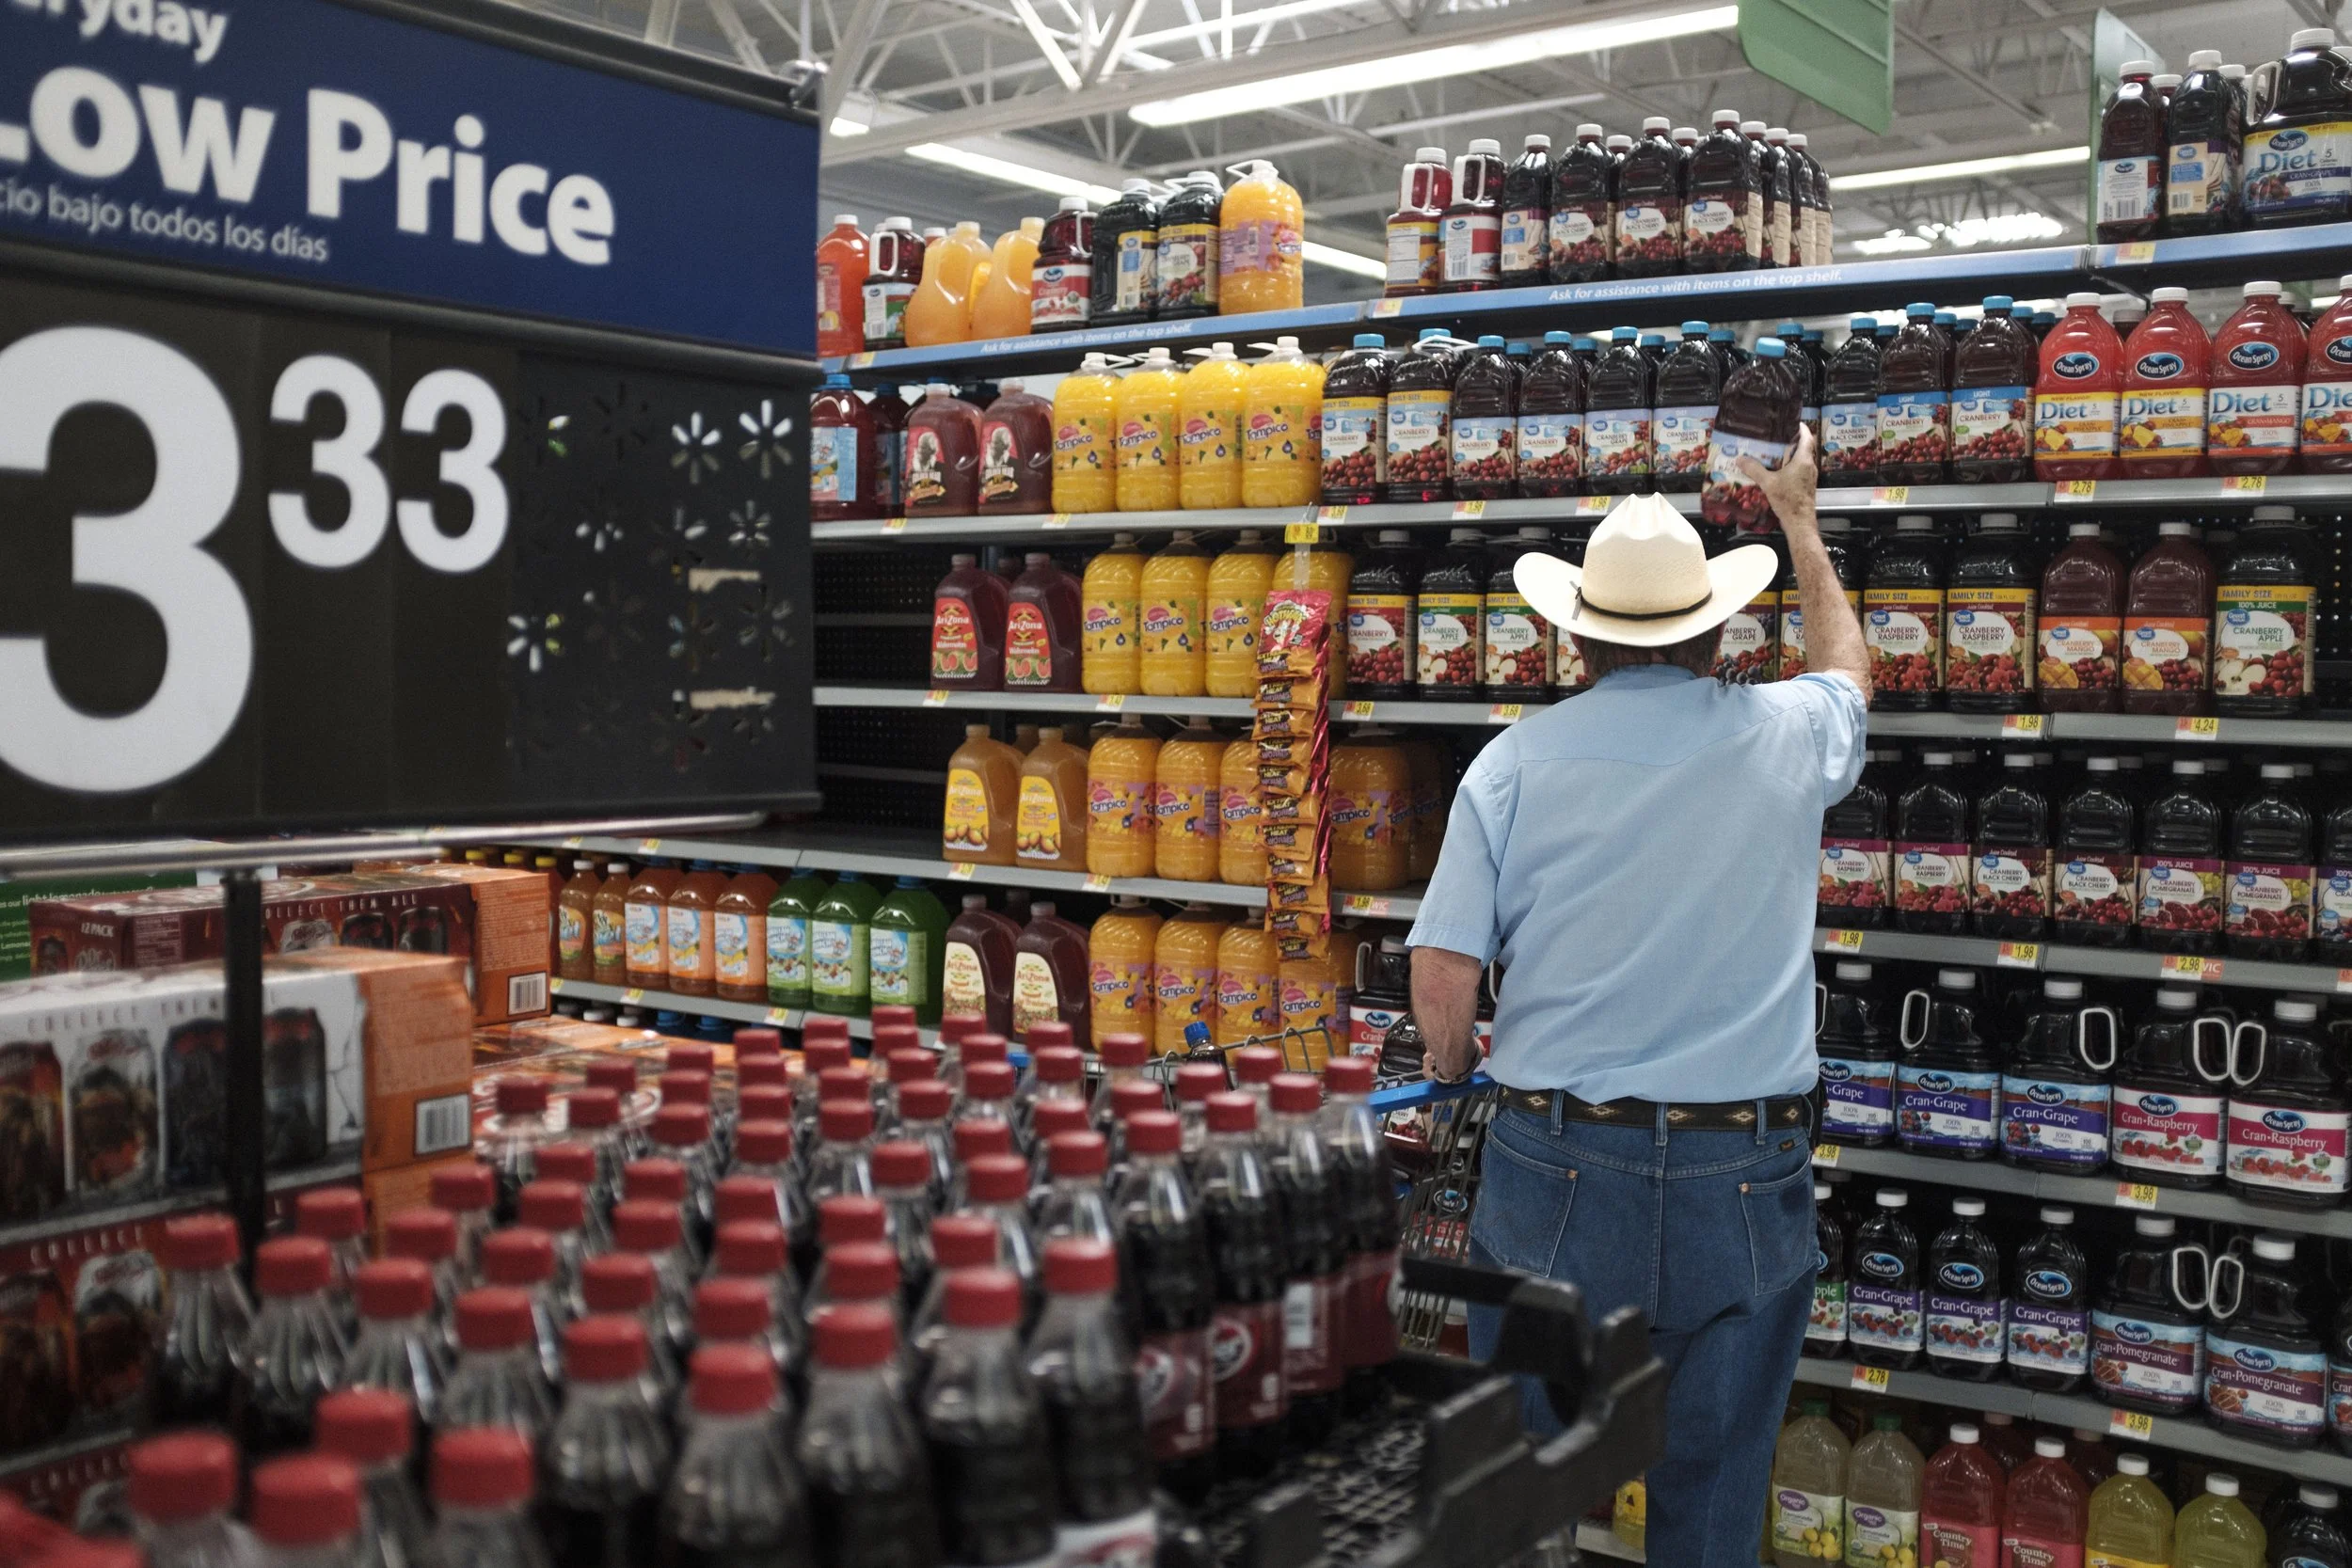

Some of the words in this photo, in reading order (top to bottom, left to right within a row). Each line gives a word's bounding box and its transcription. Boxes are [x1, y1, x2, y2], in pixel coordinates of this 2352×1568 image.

[0, 65, 276, 203] ow
[309, 87, 614, 265] Price
[2259, 150, 2317, 173] Diet
[48, 185, 122, 234] bajo
[130, 202, 216, 244] todos
[224, 215, 264, 251] los
[271, 226, 328, 261] días
[1549, 289, 1572, 301] Ask
[1574, 287, 1593, 298] for
[1595, 283, 1659, 297] assistance
[1661, 279, 1694, 292] with
[1694, 277, 1732, 290] items
[1733, 277, 1751, 288] on
[1754, 274, 1777, 286] the
[1779, 274, 1802, 288] top
[1805, 270, 1842, 282] shelf.
[980, 342, 997, 353] Ask
[999, 341, 1012, 351] for
[1013, 338, 1061, 350] assistance
[1062, 336, 1084, 346] with
[1085, 332, 1111, 343] items
[1113, 331, 1126, 340] on
[1128, 328, 1145, 339] the
[1147, 327, 1164, 340] top
[2233, 353, 2253, 364] Ocean
[2252, 351, 2271, 365] Spray
[2057, 361, 2074, 373] Ocean
[2074, 360, 2092, 374] Spray
[2139, 363, 2159, 373] Ocean
[2159, 362, 2177, 374] Spray
[2213, 391, 2272, 413] Diet
[2309, 386, 2352, 409] Die
[2041, 403, 2088, 420] Diet
[2128, 397, 2177, 416] Diet
[1118, 430, 1156, 448] Tampico
[1181, 427, 1221, 445] Tampico
[1247, 423, 1288, 441] Tampico
[1054, 434, 1092, 451] Tampico
[2073, 482, 2092, 493] 2.78
[2241, 477, 2263, 490] 2.78
[1888, 488, 1905, 499] 1.98
[0, 325, 254, 792] 3
[2222, 590, 2251, 598] FAMILY
[2254, 590, 2272, 598] SIZE
[1084, 617, 1121, 631] Tampico
[1143, 617, 1184, 632] Tampico
[1209, 616, 1249, 631] Tampico
[2257, 634, 2283, 642] APPLE
[2021, 715, 2039, 729] 1.98
[2196, 719, 2215, 731] 4.24
[1090, 800, 1127, 814] Tampico
[1154, 802, 1190, 816] Tampico
[1224, 806, 1262, 819] Tampico
[2174, 861, 2194, 869] JUICE
[2242, 865, 2259, 874] 100%
[2260, 866, 2280, 876] JUICE
[2152, 885, 2196, 894] POMEGRANATE
[2237, 892, 2282, 900] POMEGRANATE
[2245, 885, 2282, 895] CRANBERRY
[1843, 932, 1859, 944] 1.98
[2016, 944, 2034, 958] 1.98
[2181, 958, 2200, 971] 2.98
[1091, 980, 1129, 994] Tampico
[1157, 985, 1196, 999] Tampico
[1218, 991, 1257, 1005] Tampico
[2135, 1186, 2154, 1200] 3.98
[1866, 1259, 1884, 1270] Ocean
[1882, 1260, 1898, 1275] Spray
[1868, 1370, 1885, 1384] 2.78
[2128, 1417, 2149, 1430] 3.98
[1779, 1494, 1805, 1505] Organic
[1854, 1512, 1883, 1522] Organic
[1932, 1529, 1972, 1545] Country
[1940, 1537, 1965, 1551] Time
[2013, 1545, 2054, 1562] Country
[2021, 1554, 2046, 1567] Time
